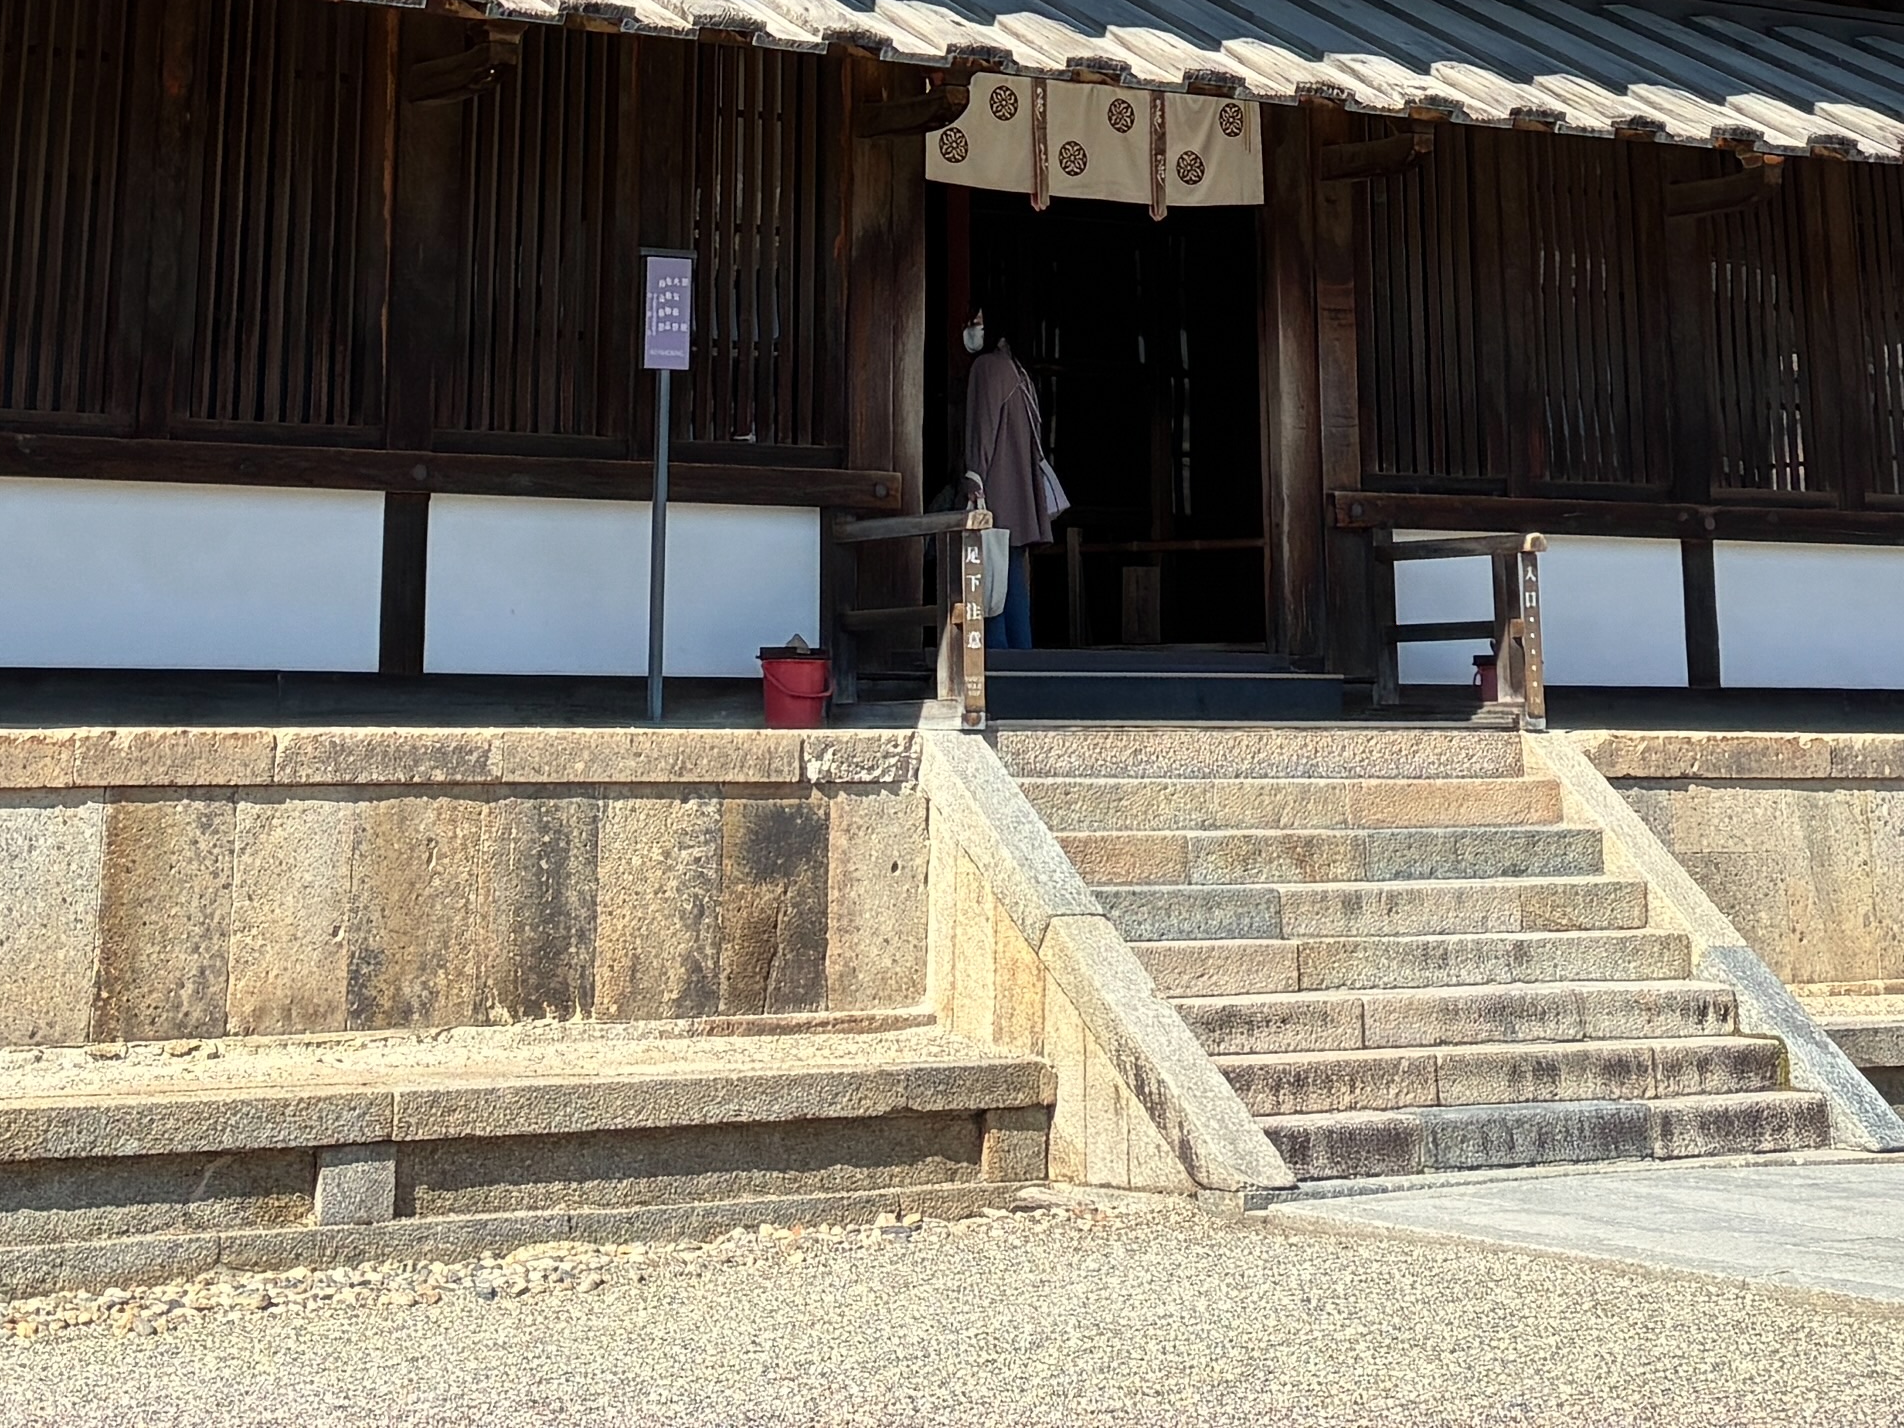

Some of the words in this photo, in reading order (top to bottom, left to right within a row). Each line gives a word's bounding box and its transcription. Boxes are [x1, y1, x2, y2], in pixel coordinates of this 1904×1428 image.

[966, 546, 982, 649] 足下注意
[1525, 566, 1536, 608] 入口
